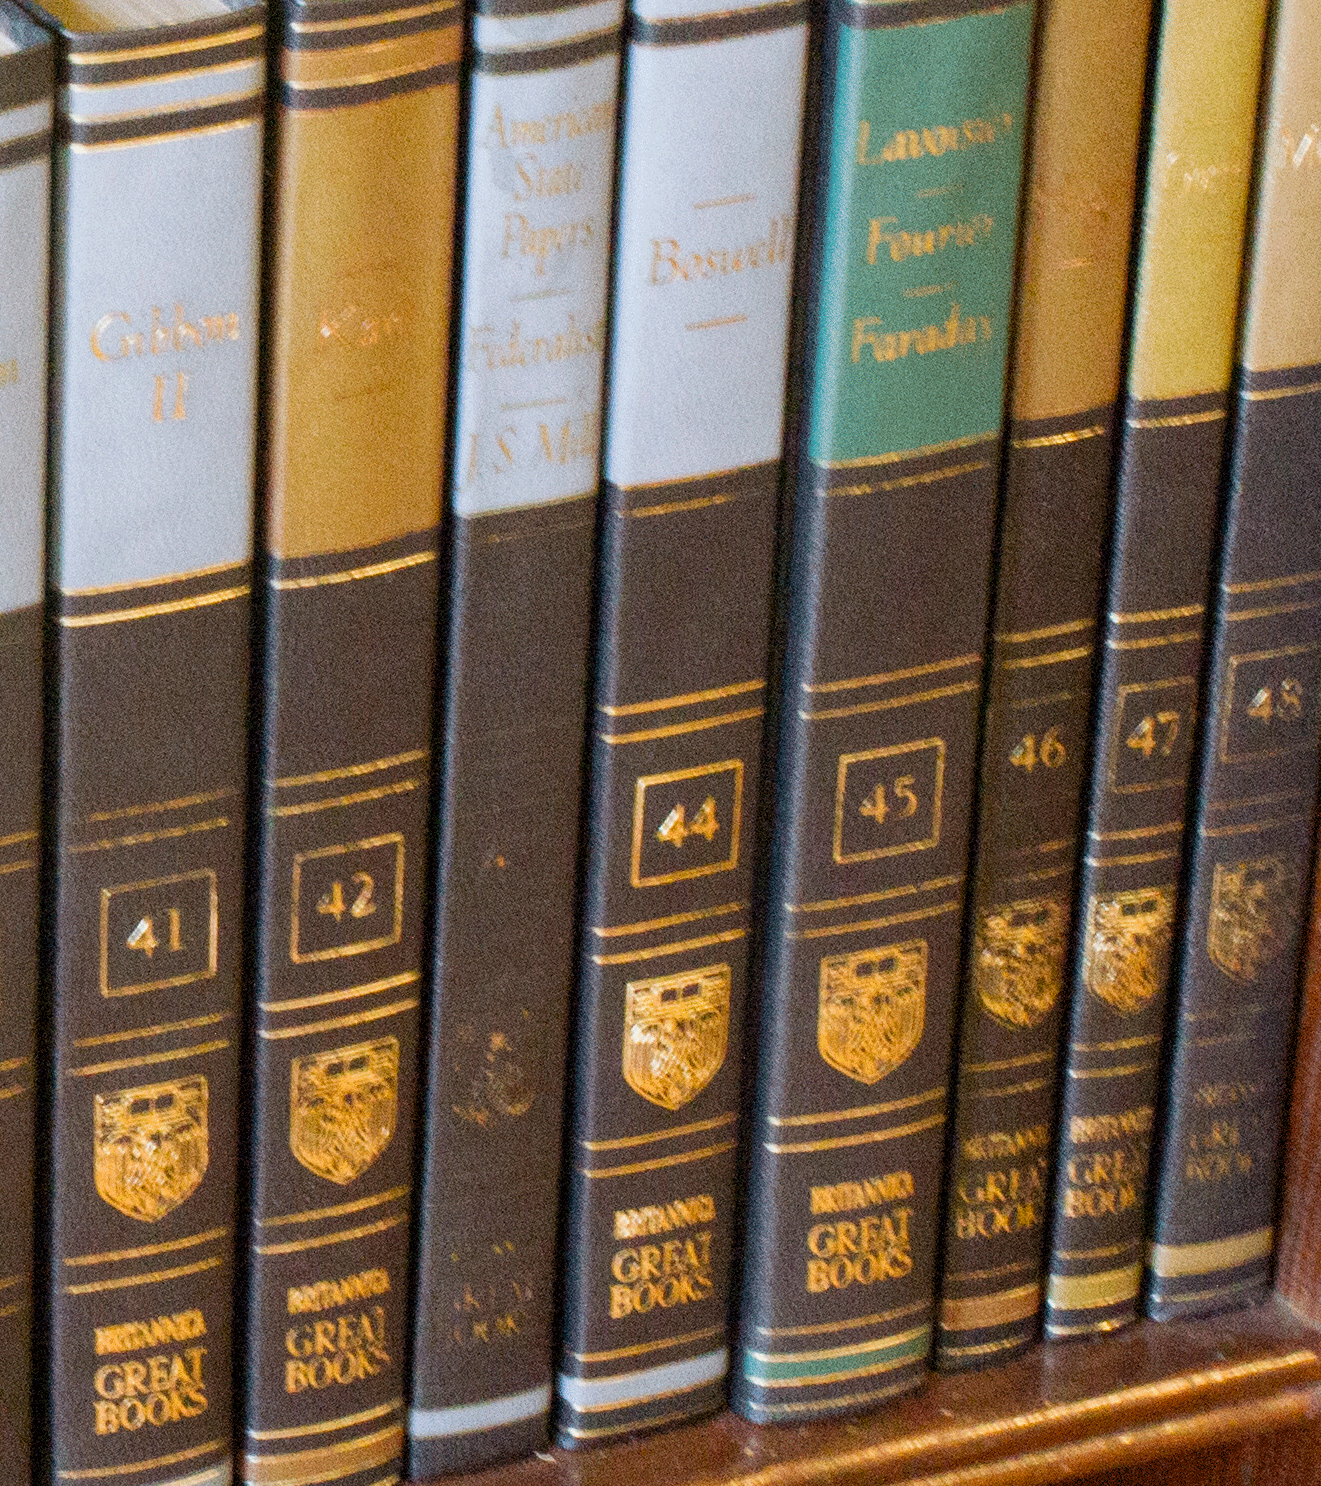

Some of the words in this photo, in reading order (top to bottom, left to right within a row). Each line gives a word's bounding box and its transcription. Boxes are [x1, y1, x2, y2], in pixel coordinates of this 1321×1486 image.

[648, 212, 797, 287] Boswell
[88, 304, 241, 363] Gibbon
[150, 370, 190, 422] II
[1246, 676, 1305, 724] 48
[1008, 724, 1069, 773] 46
[1124, 709, 1181, 758] 47
[655, 794, 720, 849] 44
[859, 774, 919, 825] 45
[315, 869, 377, 921] 42
[123, 906, 183, 960] 41
[610, 1231, 713, 1285] GREAT
[806, 1208, 913, 1262] GREAT
[608, 1268, 714, 1320] BOOKS
[805, 1247, 913, 1294] BOOKS
[285, 1306, 387, 1358] GREAT
[91, 1346, 207, 1400] GREAT
[285, 1344, 392, 1394] BOOKS
[91, 1386, 210, 1436] BOOKS
